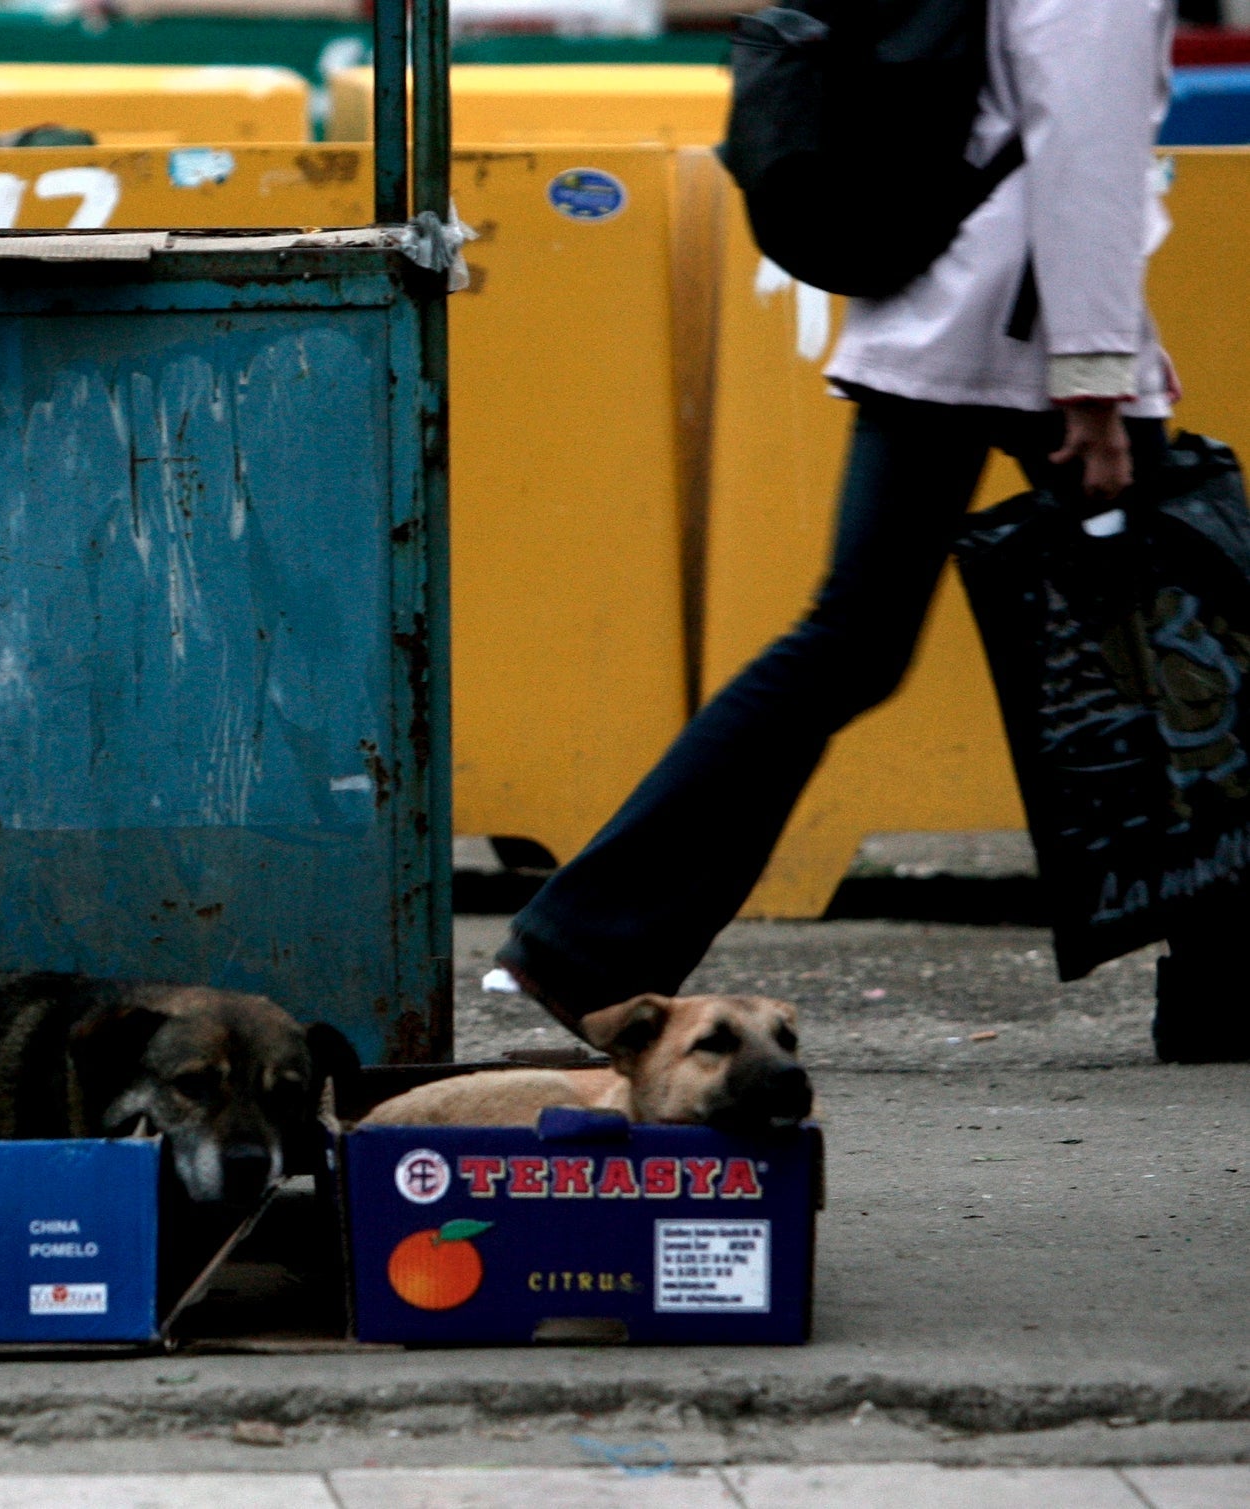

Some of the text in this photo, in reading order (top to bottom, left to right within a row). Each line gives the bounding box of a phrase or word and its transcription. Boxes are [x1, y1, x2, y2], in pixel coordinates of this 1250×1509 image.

[458, 1156, 763, 1200] TEKASYA
[29, 1219, 80, 1236] CHINA
[29, 1241, 99, 1258] POMELO
[528, 1271, 635, 1292] CITRUS
